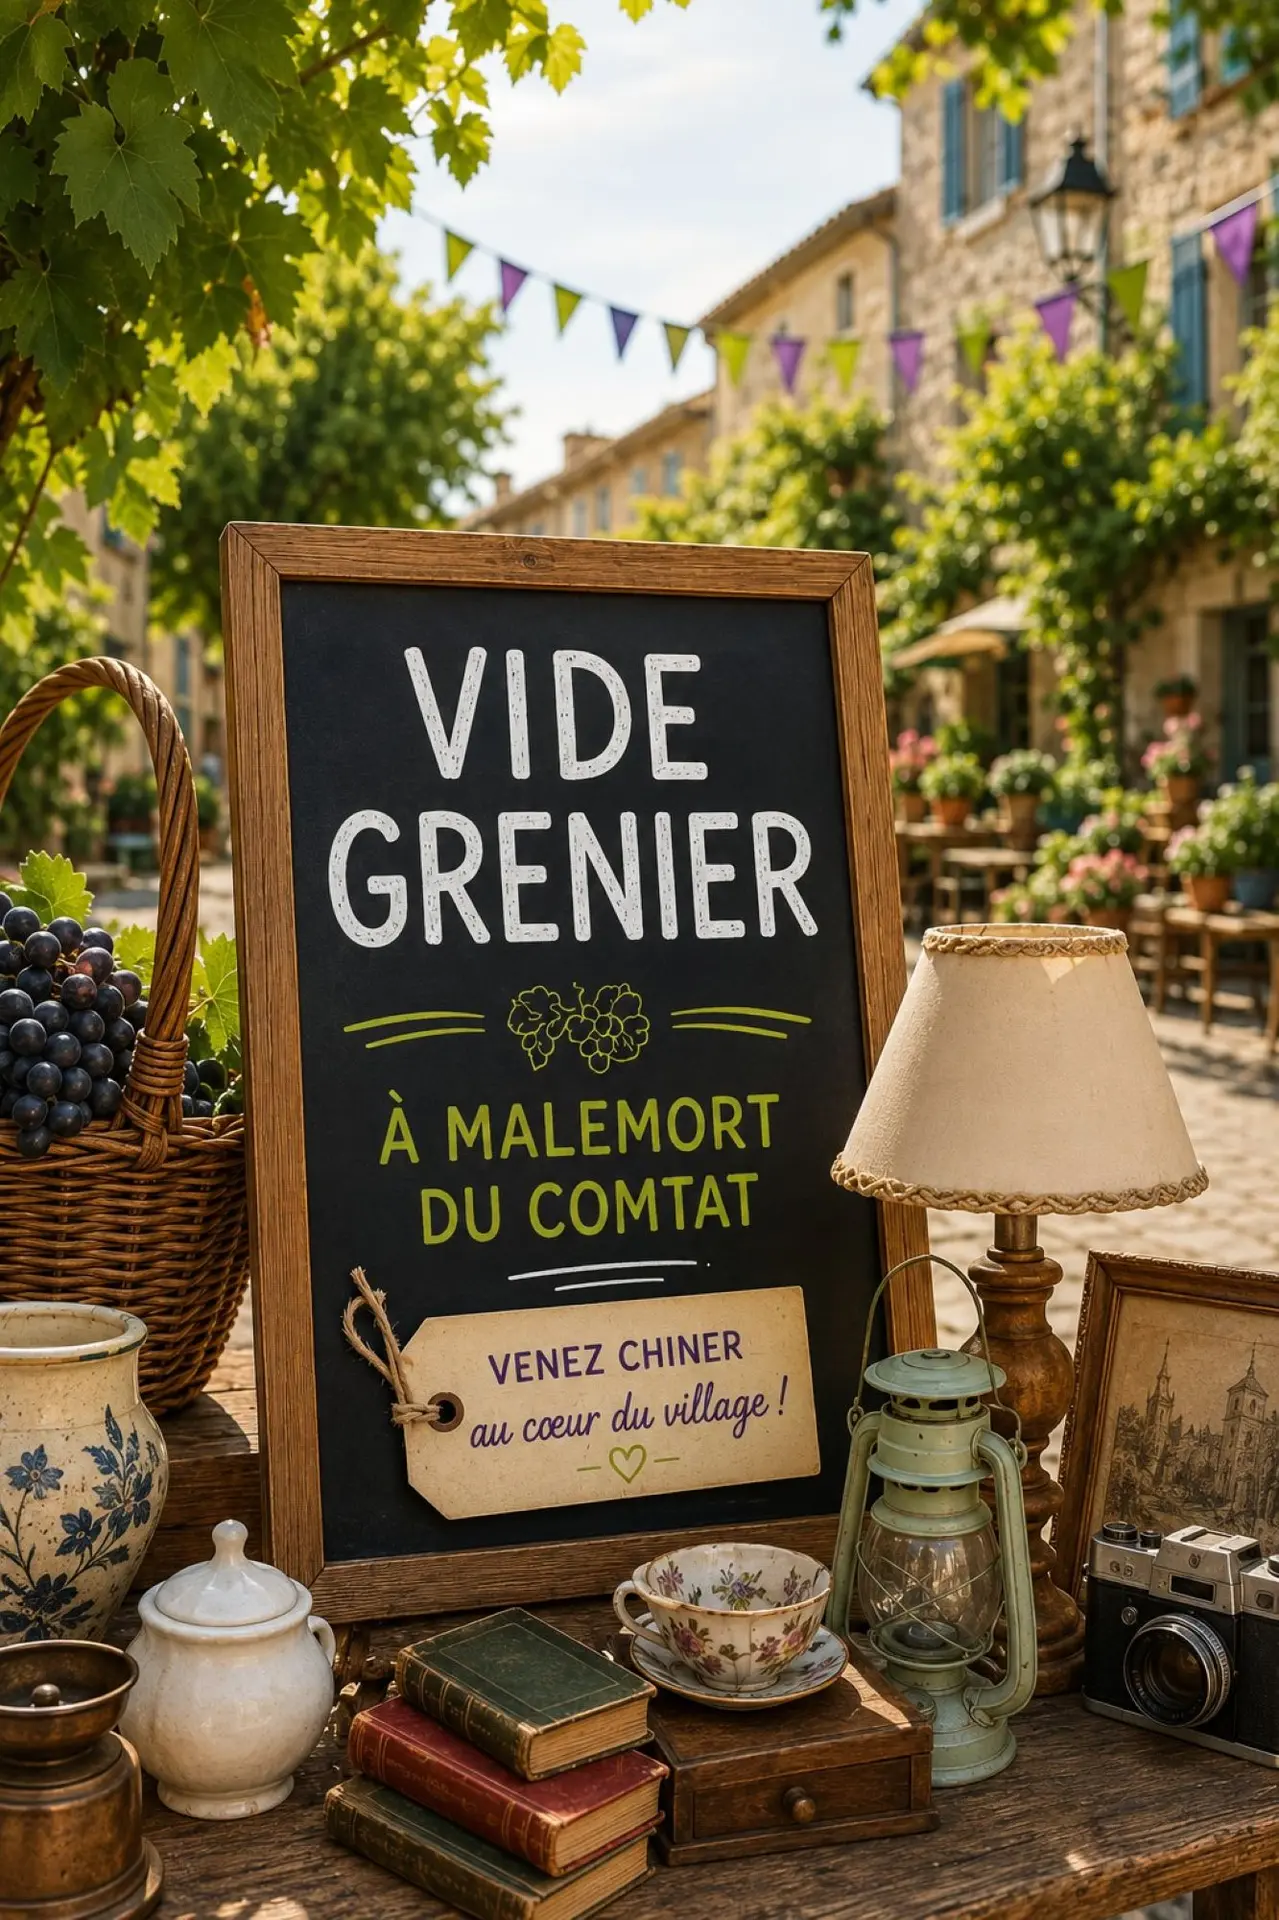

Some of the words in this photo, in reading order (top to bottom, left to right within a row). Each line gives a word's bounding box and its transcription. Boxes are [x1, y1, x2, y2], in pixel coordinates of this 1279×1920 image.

[403, 646, 708, 781] VIDE
[328, 809, 819, 948] GRENIER
[380, 1089, 419, 1165] À
[447, 1093, 780, 1161] MALEMORT
[421, 1185, 501, 1245] DU
[528, 1172, 759, 1238] COMTAT
[487, 1343, 605, 1386] VENEZ
[618, 1329, 743, 1372] CHINER
[469, 1421, 514, 1448] au
[522, 1411, 602, 1443] cœur
[611, 1390, 656, 1433] du
